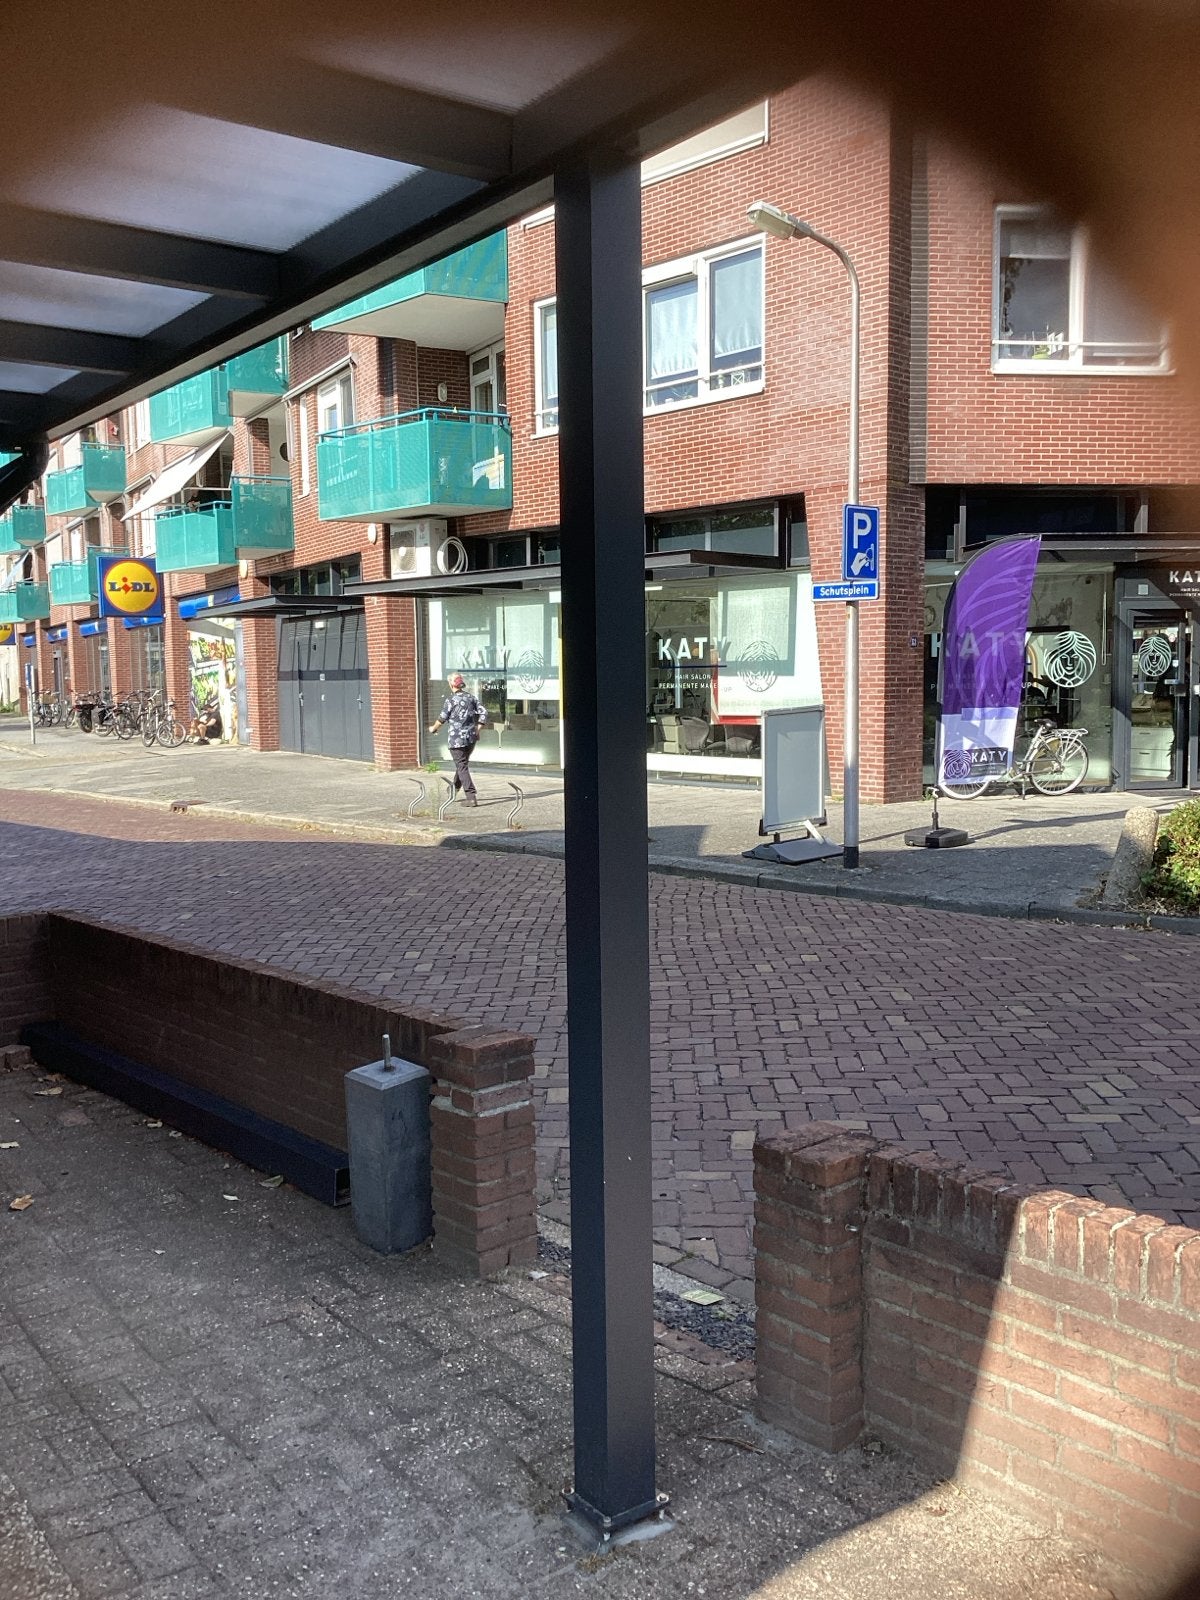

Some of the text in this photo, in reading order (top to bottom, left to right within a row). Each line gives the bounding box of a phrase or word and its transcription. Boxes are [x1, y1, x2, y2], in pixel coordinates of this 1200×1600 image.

[853, 512, 872, 549] P
[820, 585, 869, 597] Schutsplein
[457, 644, 509, 669] KATY
[658, 636, 728, 661] KATY
[658, 682, 699, 690] PERMANENTE
[971, 750, 1007, 763] KATY
